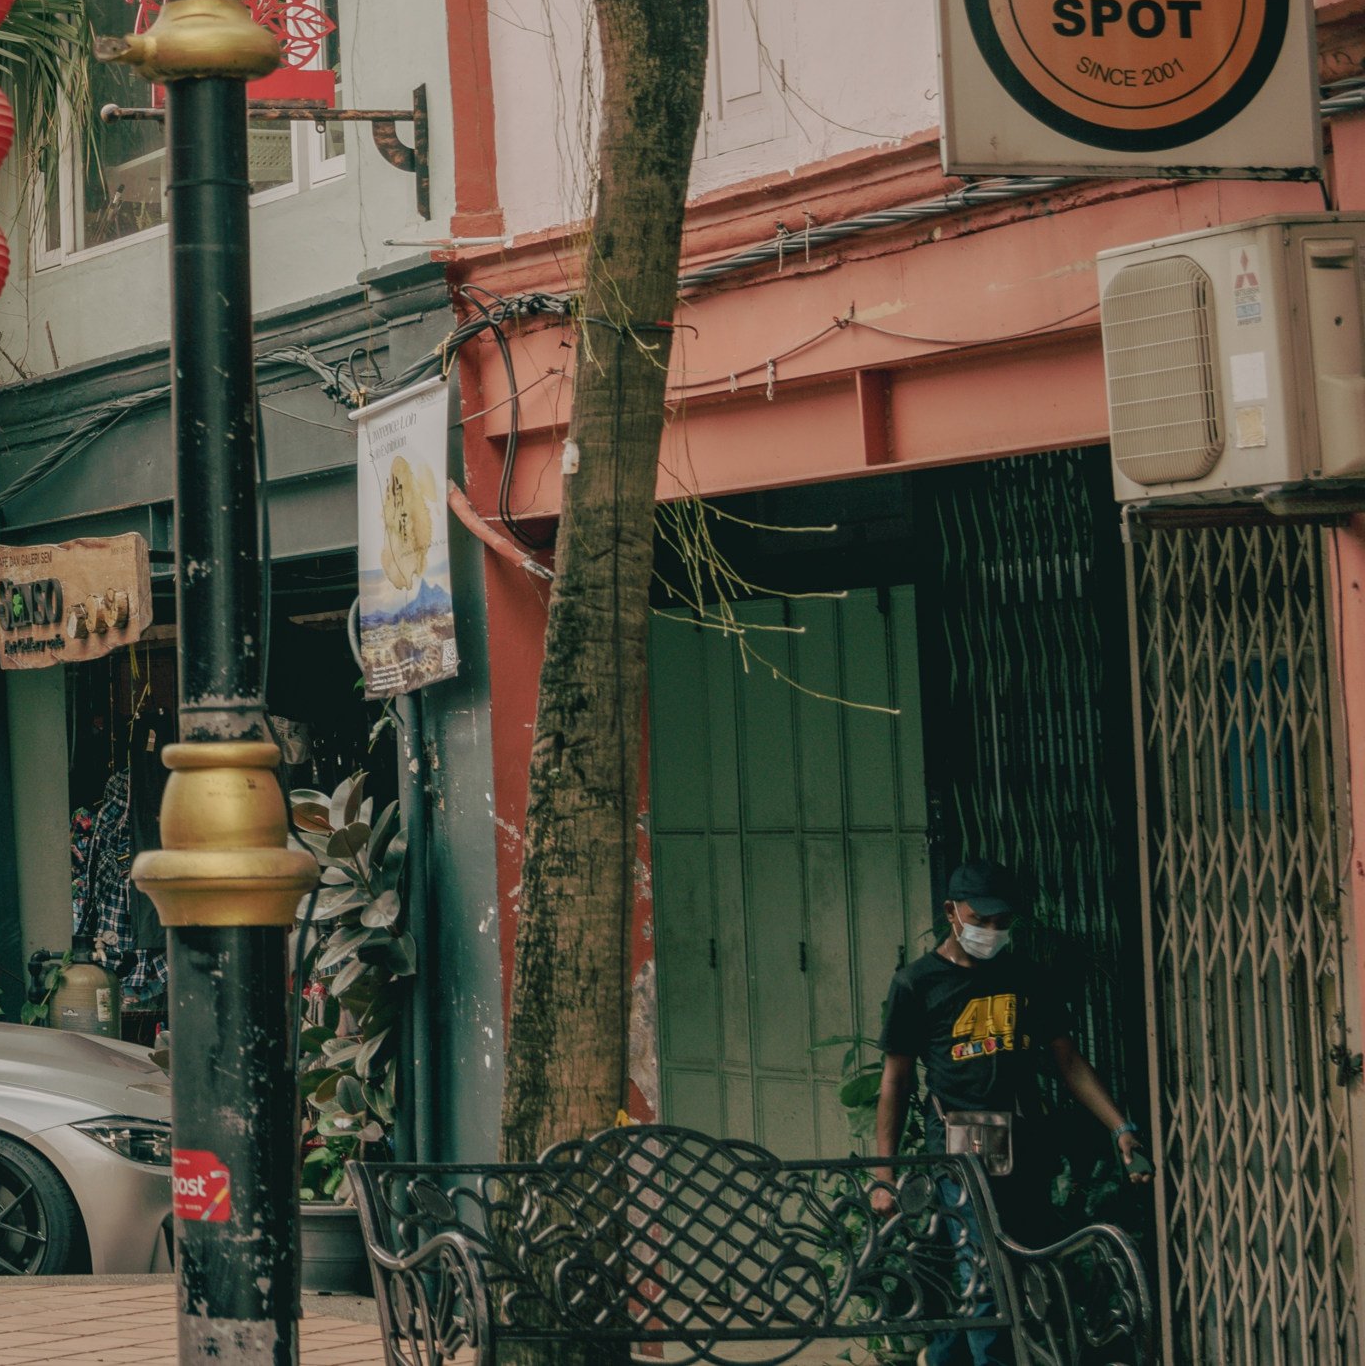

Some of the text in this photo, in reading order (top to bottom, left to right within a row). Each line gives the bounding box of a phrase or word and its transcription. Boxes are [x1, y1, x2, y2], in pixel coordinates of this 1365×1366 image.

[1076, 56, 1186, 87] SINCE 2001
[9, 554, 19, 567] DAN
[20, 552, 40, 566] GALERI
[952, 994, 1017, 1040] 46
